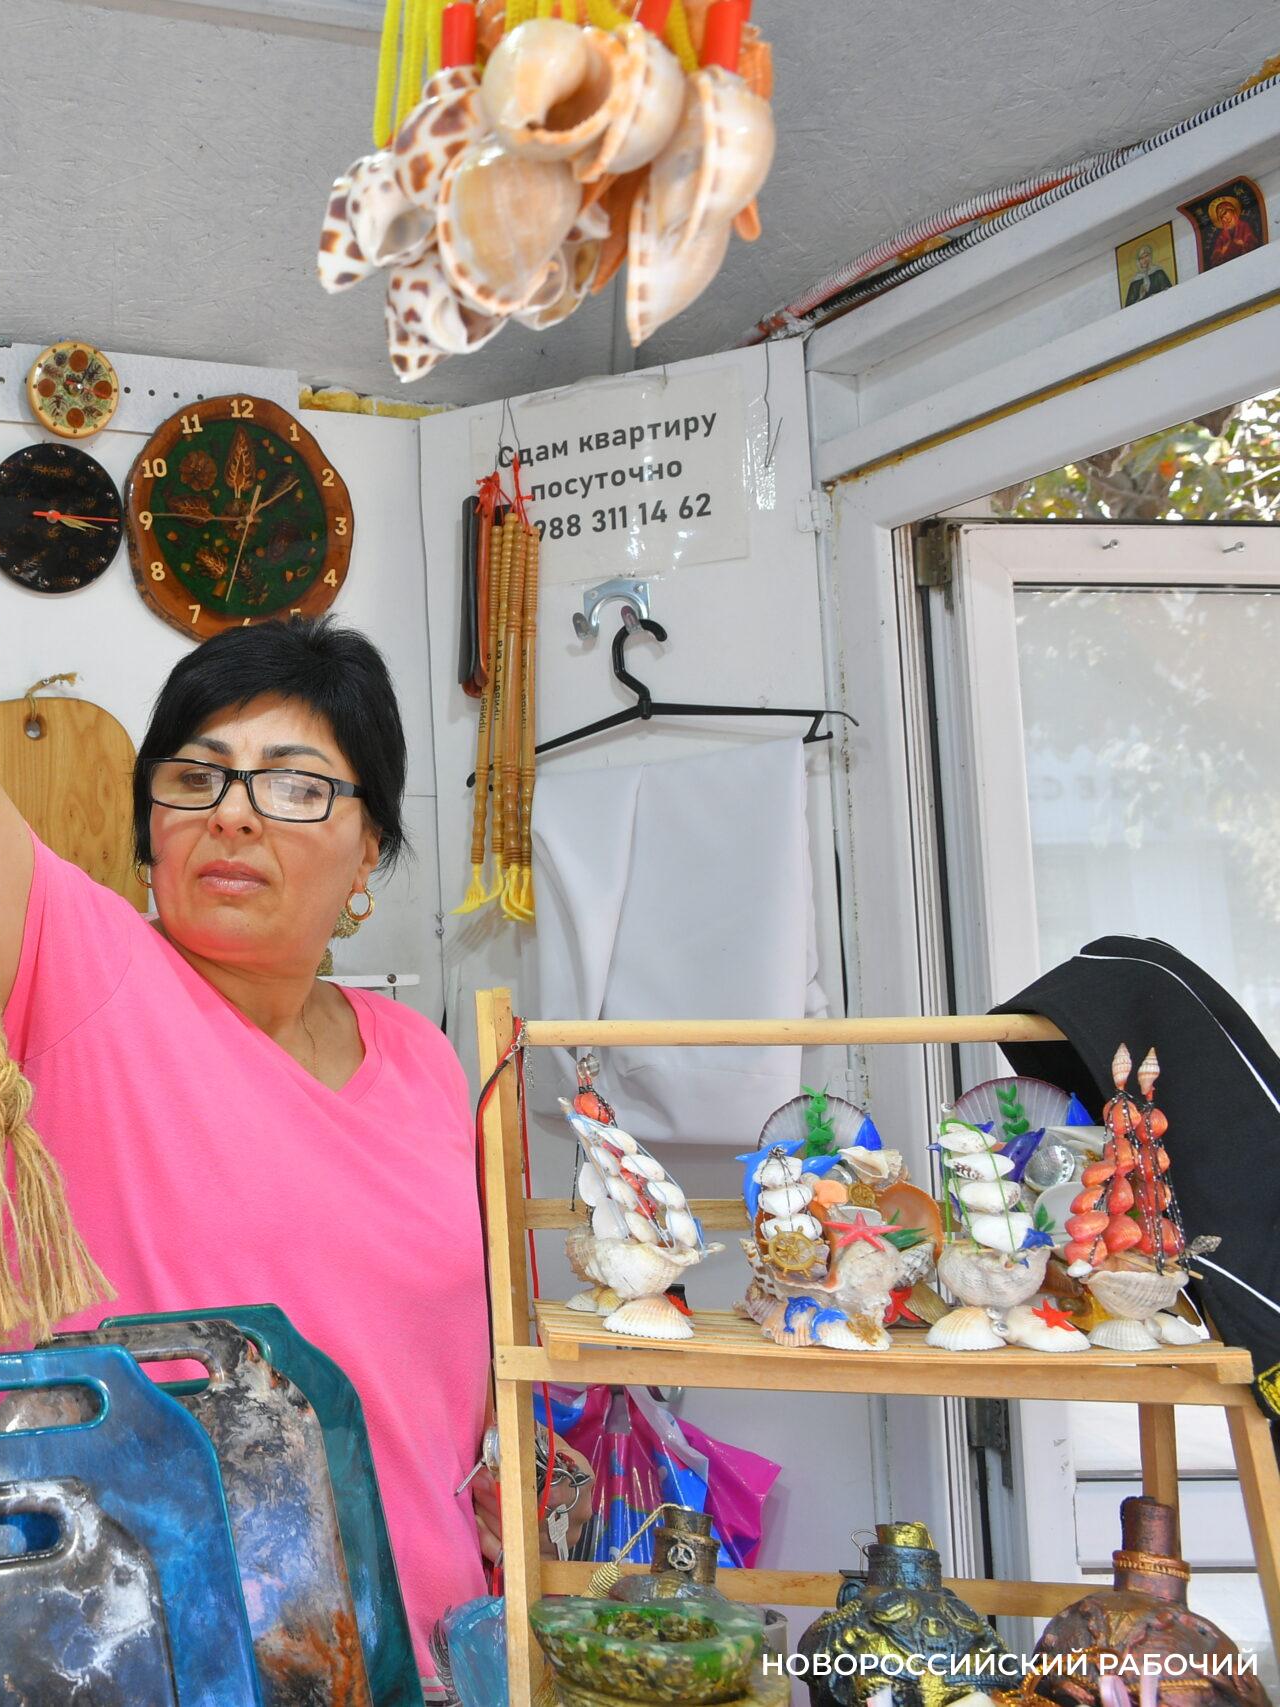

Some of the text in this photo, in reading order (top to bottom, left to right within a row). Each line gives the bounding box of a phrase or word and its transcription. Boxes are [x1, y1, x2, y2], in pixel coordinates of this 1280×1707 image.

[230, 399, 254, 419] 12
[180, 414, 203, 434] 11
[289, 424, 300, 442] 1
[497, 412, 717, 469] Сдам квартиру
[141, 458, 168, 478] 10
[322, 468, 335, 487] 2
[531, 460, 683, 502] посуточно
[138, 511, 154, 531] 9
[591, 505, 628, 534] 311
[639, 499, 668, 524] 14
[678, 492, 712, 520] 62
[334, 517, 348, 536] 3
[150, 562, 166, 581] 8
[323, 569, 338, 588] 4
[188, 604, 202, 624] 7
